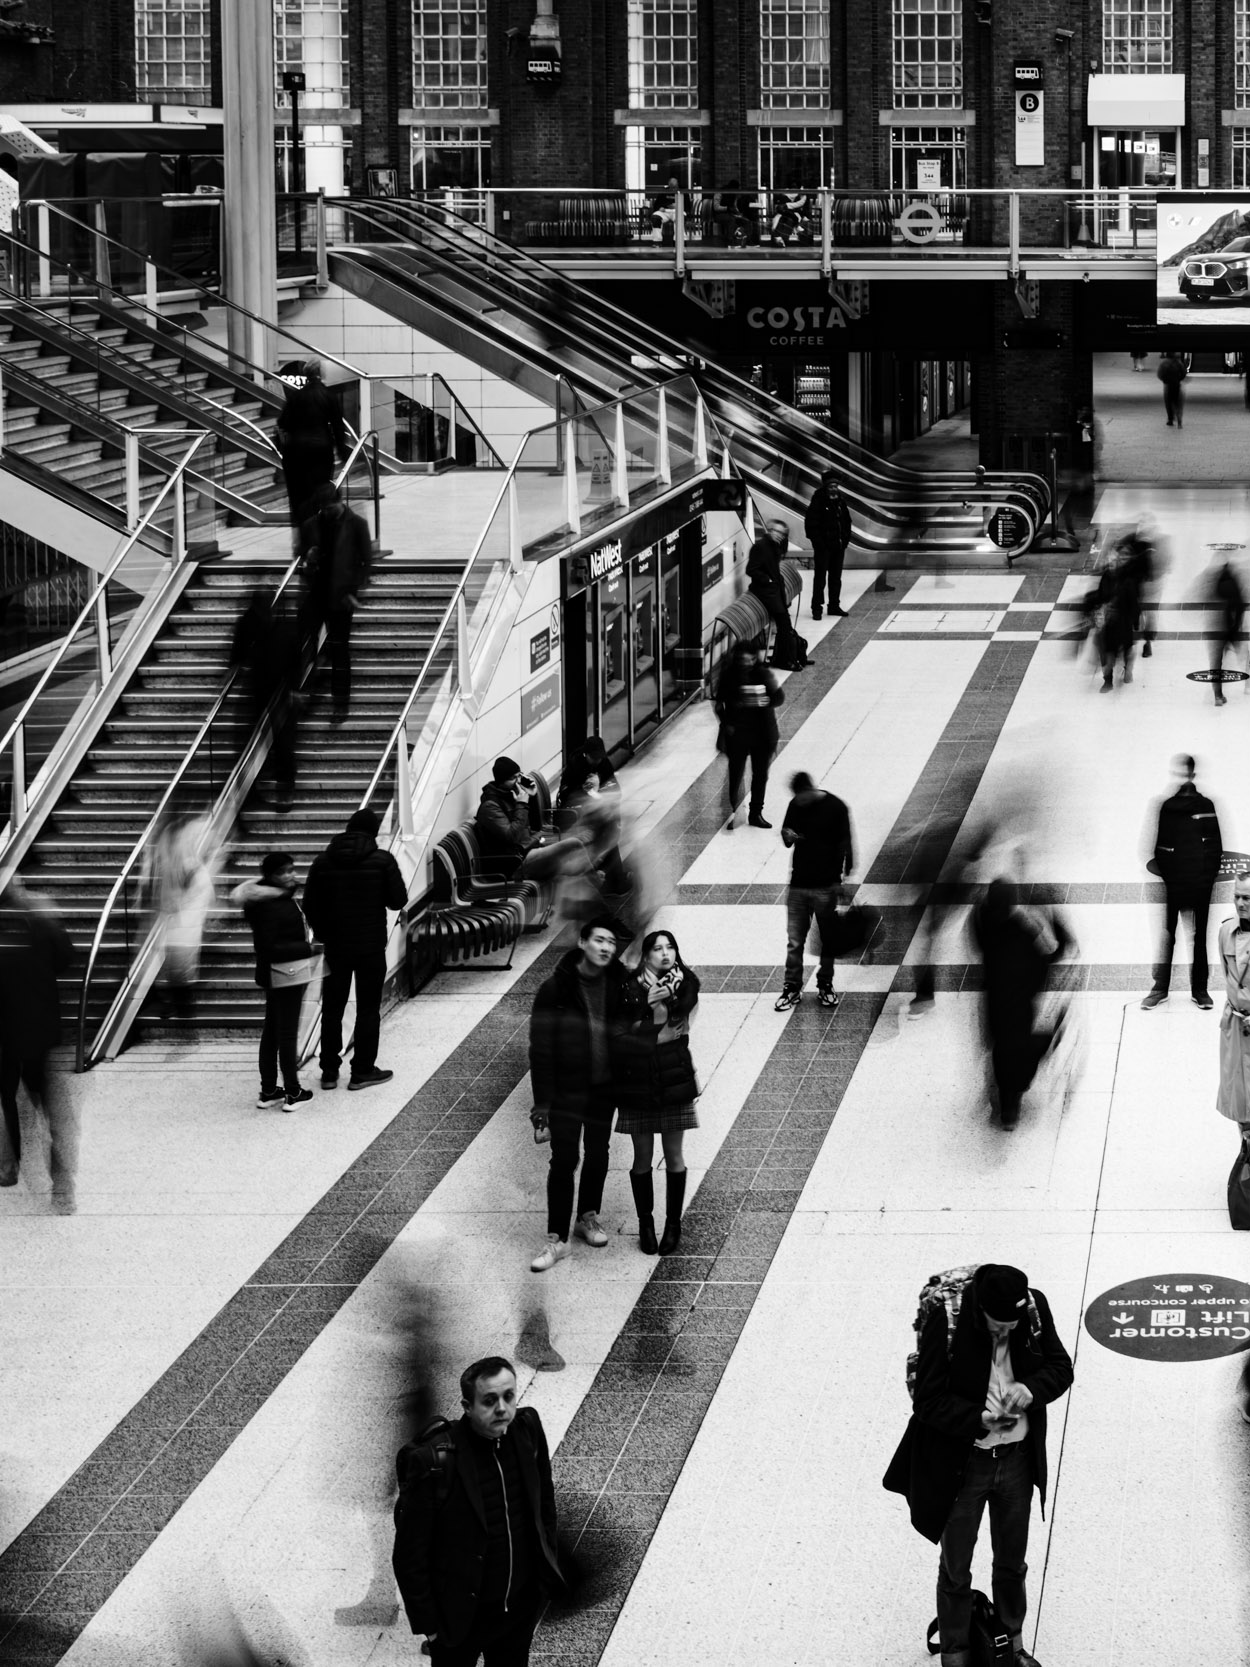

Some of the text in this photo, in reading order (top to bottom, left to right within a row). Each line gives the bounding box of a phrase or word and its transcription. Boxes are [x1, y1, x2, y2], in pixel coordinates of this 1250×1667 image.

[1025, 96, 1035, 110] B
[746, 306, 848, 333] COSTA
[769, 336, 825, 346] COFFEE
[280, 374, 309, 387] COST
[590, 538, 622, 579] NatWest
[1108, 1298, 1187, 1306] concourse
[1190, 1298, 1236, 1306] upper
[1200, 1310, 1250, 1324] Lift
[1108, 1326, 1250, 1340] Customer
